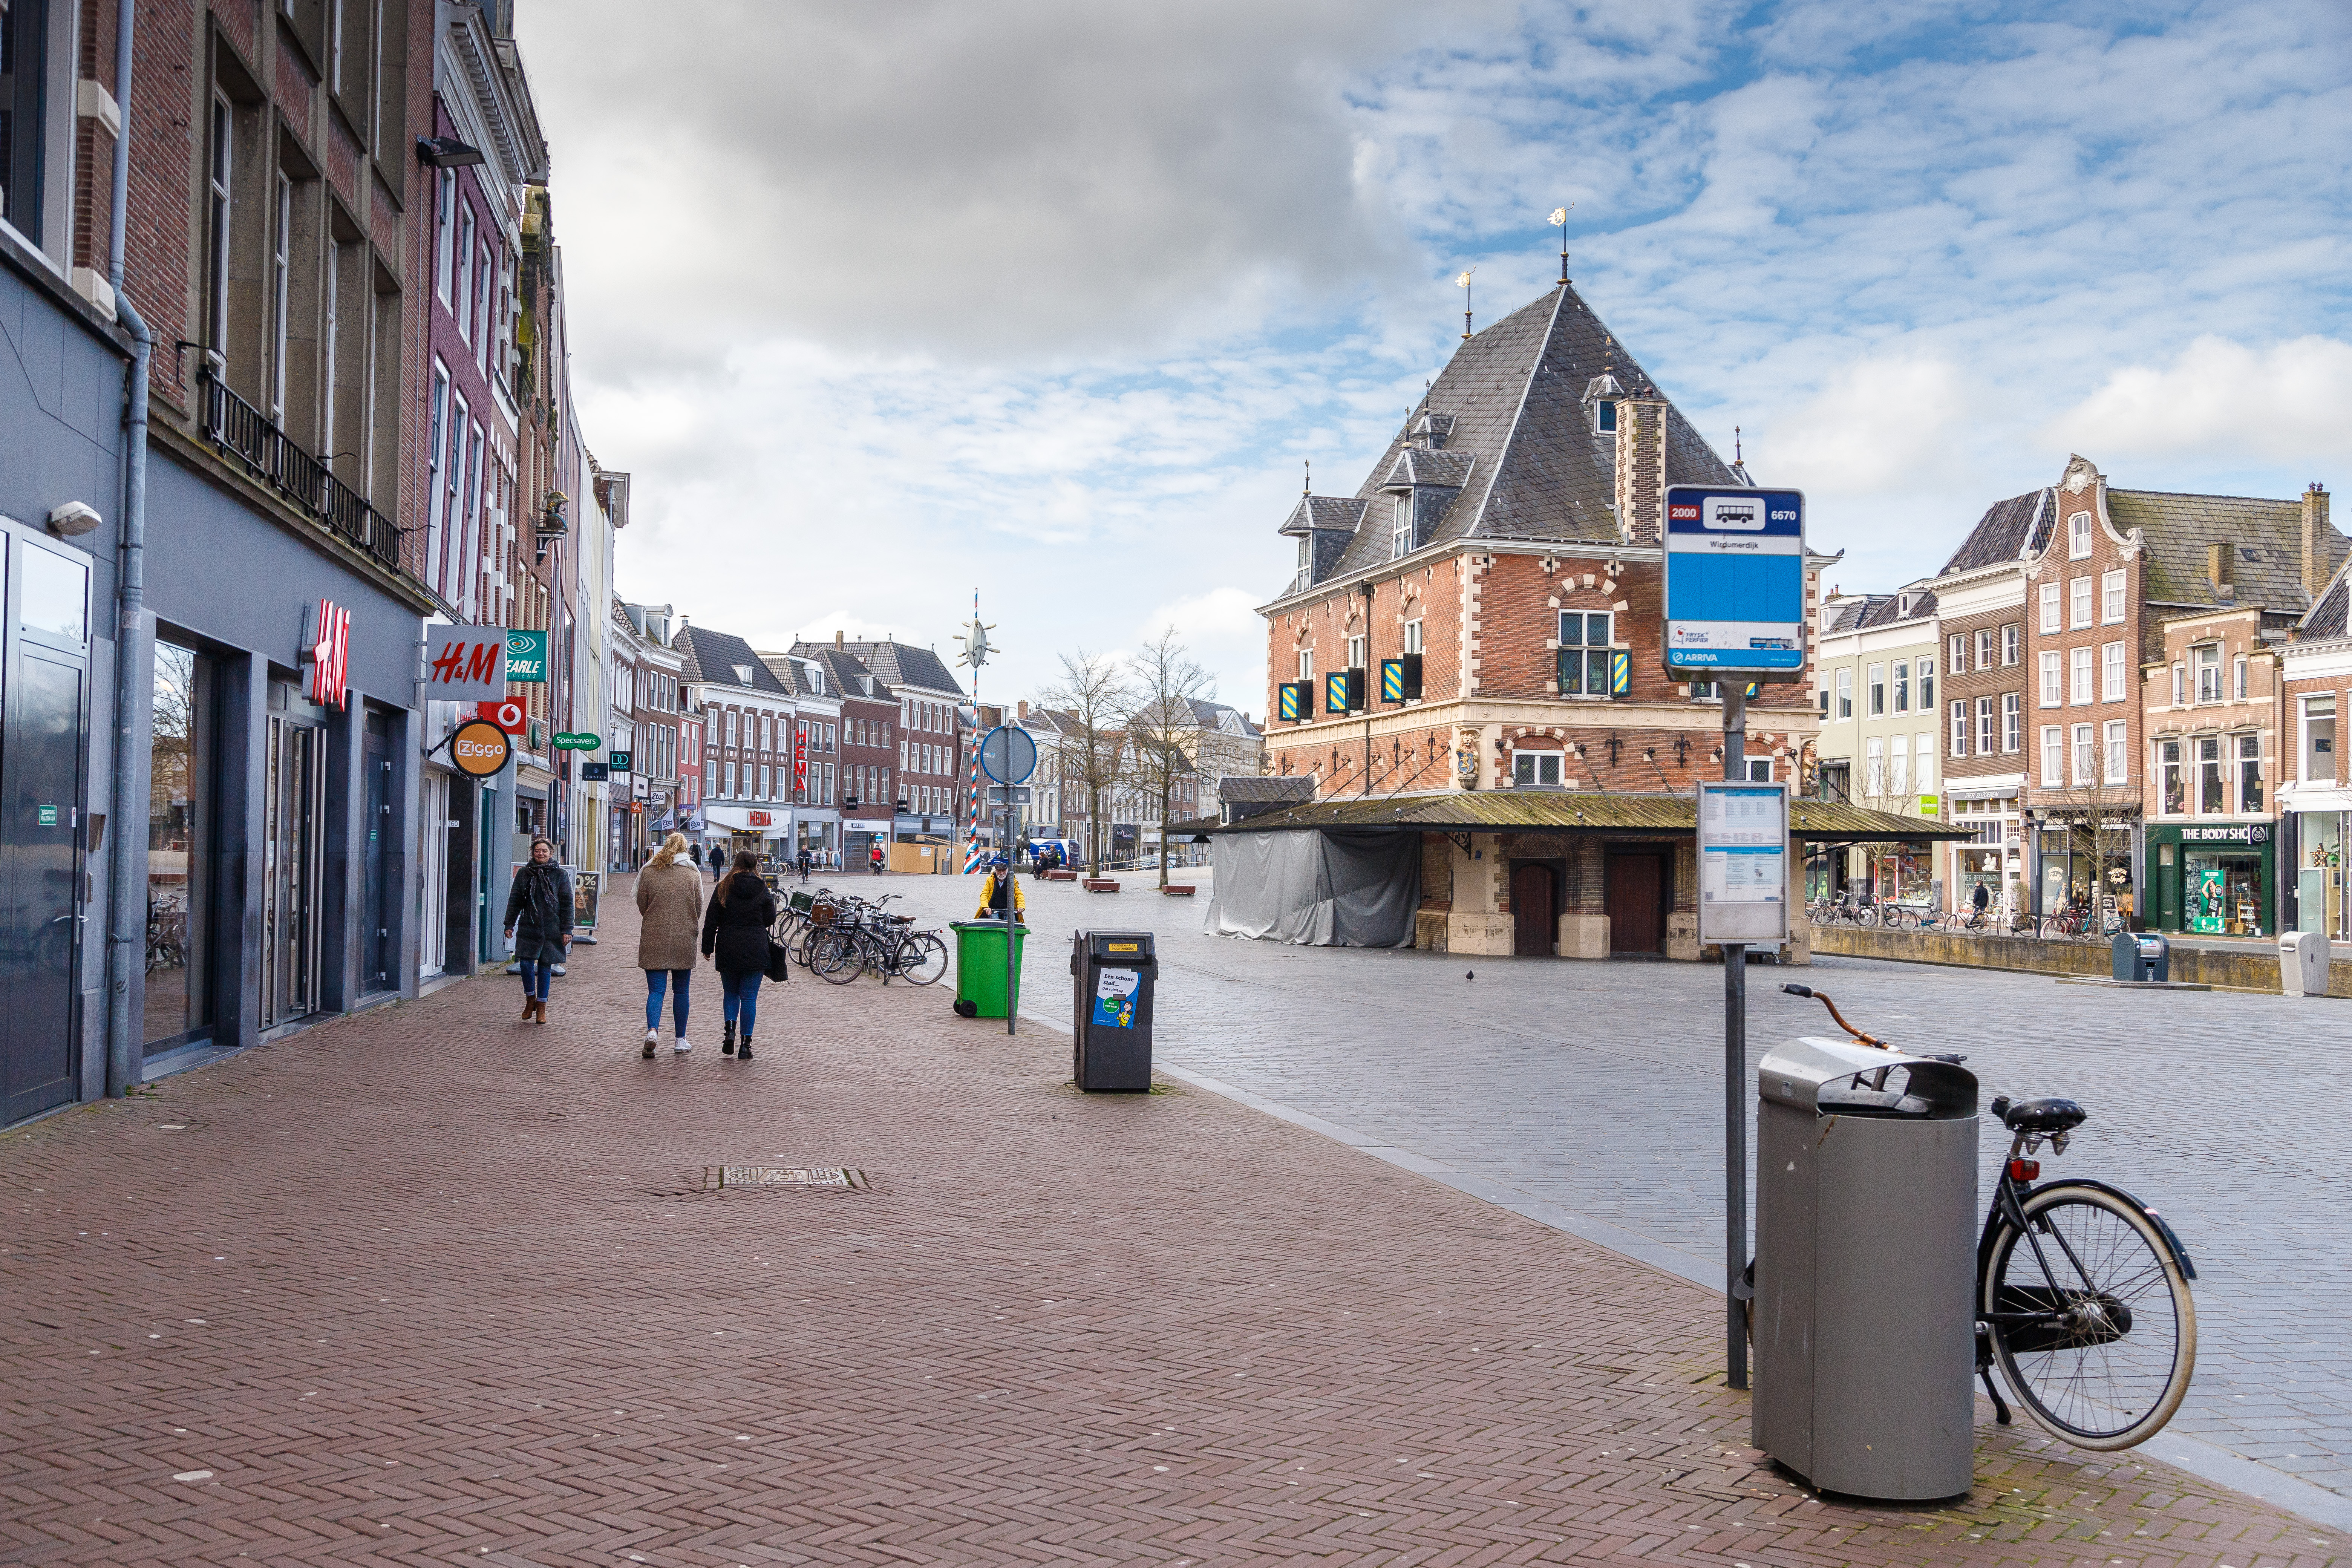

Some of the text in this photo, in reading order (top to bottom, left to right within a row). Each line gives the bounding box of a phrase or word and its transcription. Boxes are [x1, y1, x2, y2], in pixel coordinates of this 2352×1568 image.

[1671, 507, 1697, 518] 2000
[1771, 510, 1796, 521] 6670
[1710, 541, 1758, 550] Wirdumerdijk
[432, 642, 499, 685] H&M
[507, 660, 541, 673] EARLE
[556, 737, 596, 745] Specsavers
[795, 730, 807, 791] HEMA
[748, 811, 772, 826] HEMA
[2181, 828, 2248, 839] THE BODY SHO
[575, 875, 596, 888] 0%
